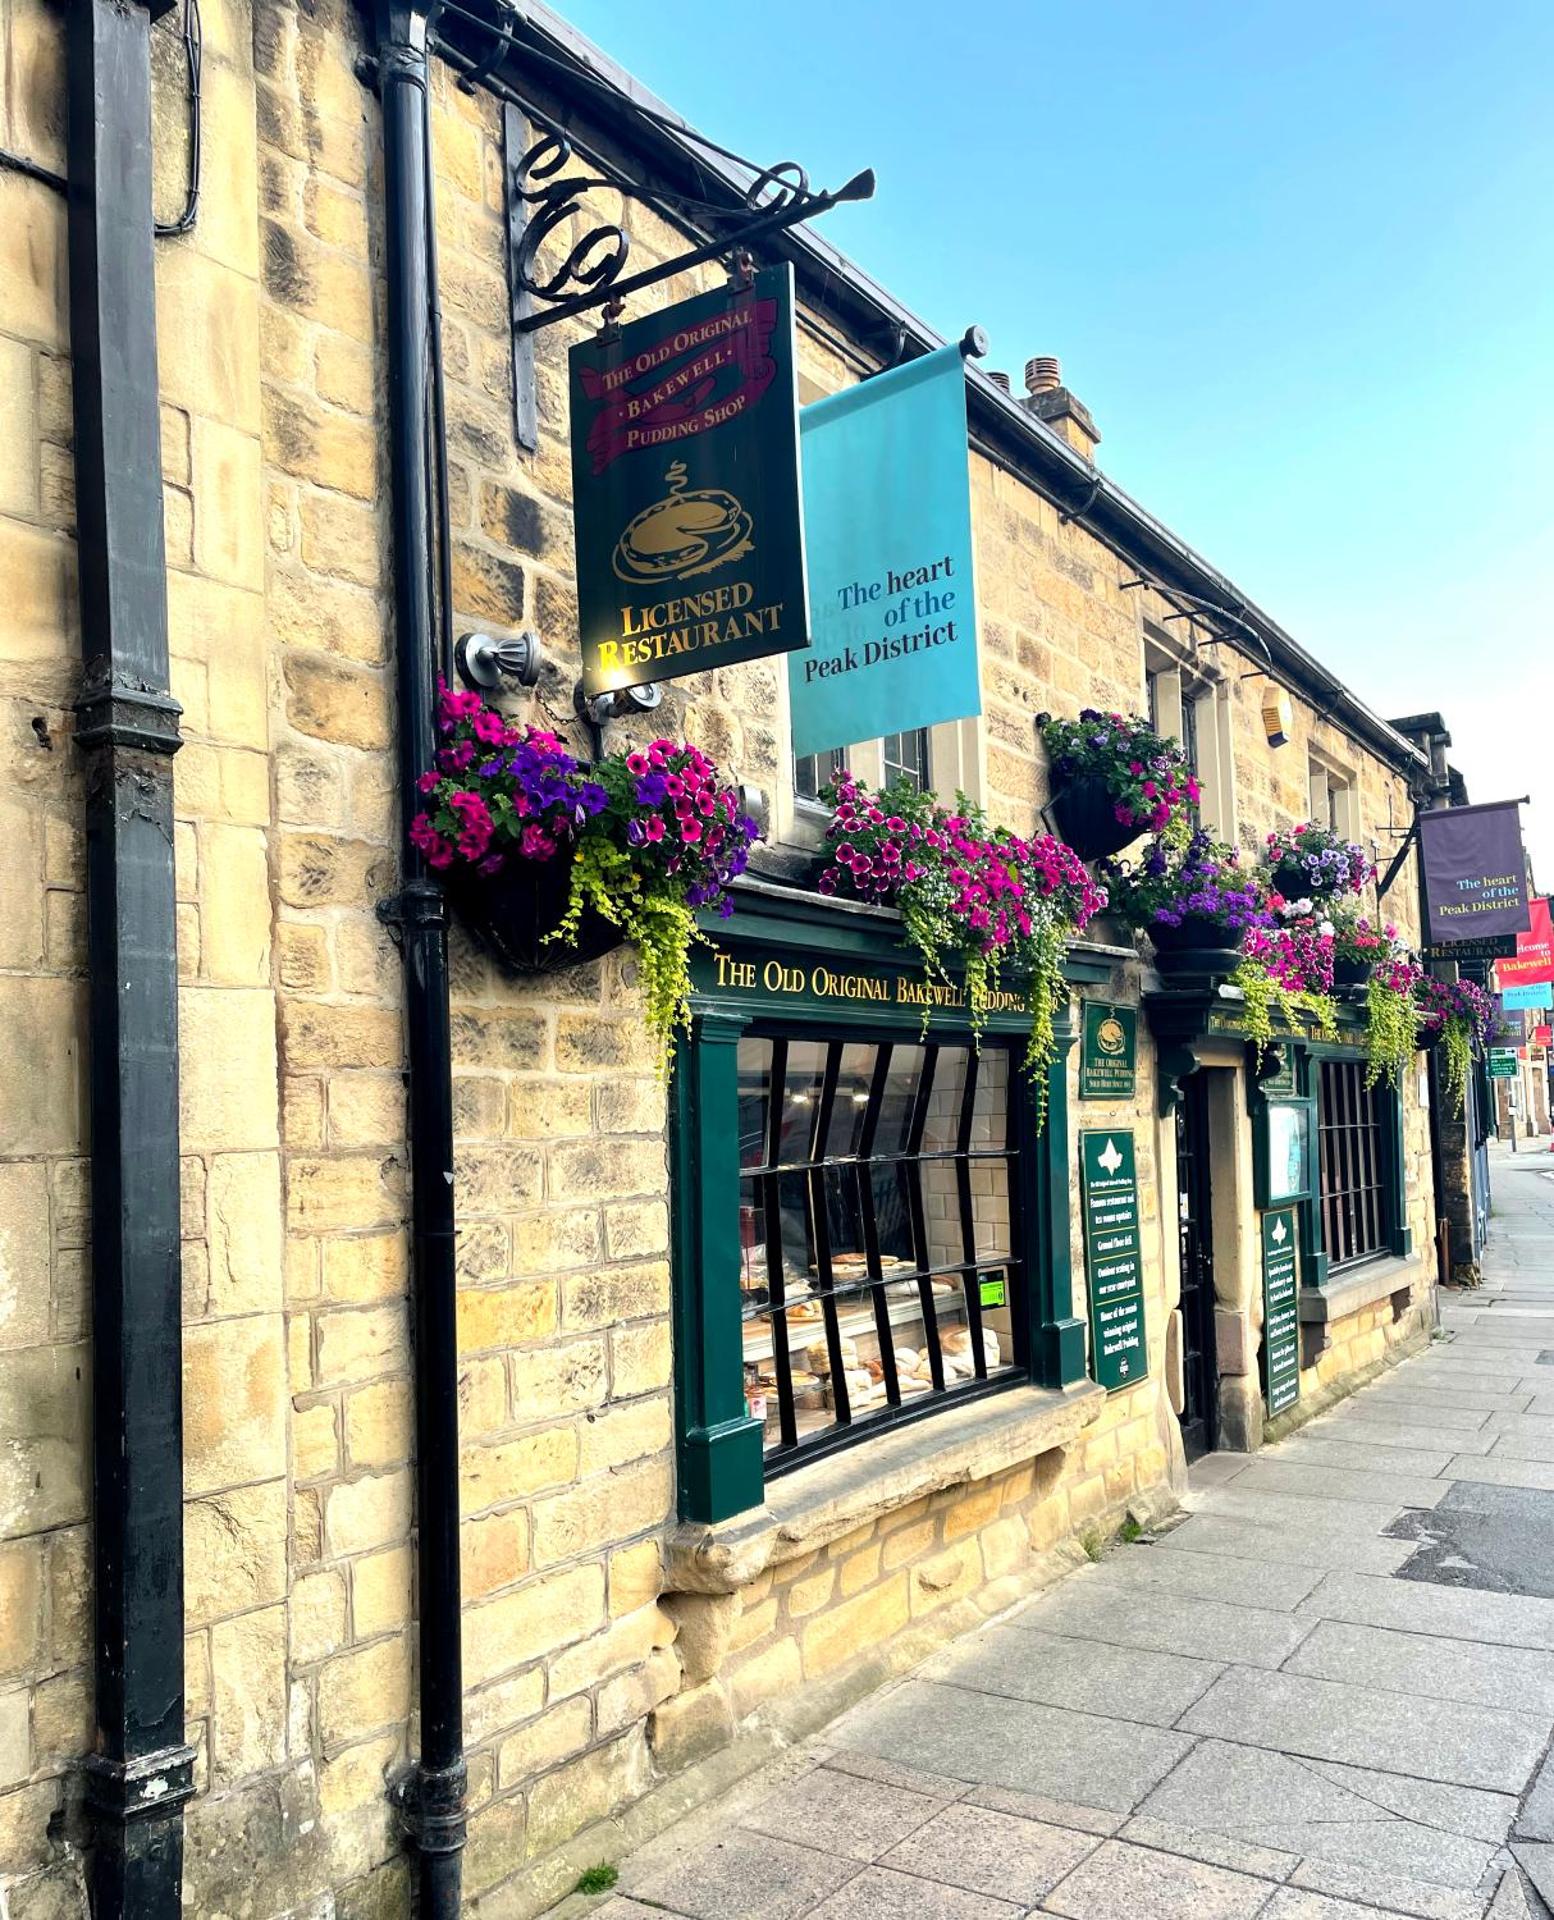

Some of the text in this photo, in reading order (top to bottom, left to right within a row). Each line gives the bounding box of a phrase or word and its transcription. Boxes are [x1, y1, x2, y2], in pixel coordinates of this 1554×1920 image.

[603, 311, 753, 391] THE OLD ORIGINAL
[627, 351, 725, 418] BAKEWELL
[627, 395, 746, 448] PUDDING SHOP
[838, 555, 955, 610] The heart
[621, 582, 753, 637] LICENSED
[884, 591, 956, 627] of the
[598, 603, 784, 672] RESTAURANT
[804, 621, 958, 683] Peak District
[1456, 874, 1517, 890] The heart
[1482, 886, 1519, 898] of the
[1440, 898, 1520, 916] Peak District
[1431, 944, 1509, 957] RESTAURANT
[1503, 957, 1552, 971] Bakewell
[1541, 949, 1550, 957] to
[714, 953, 756, 988] THE
[764, 960, 805, 992] OLD
[812, 966, 891, 1001] ORIGINAL
